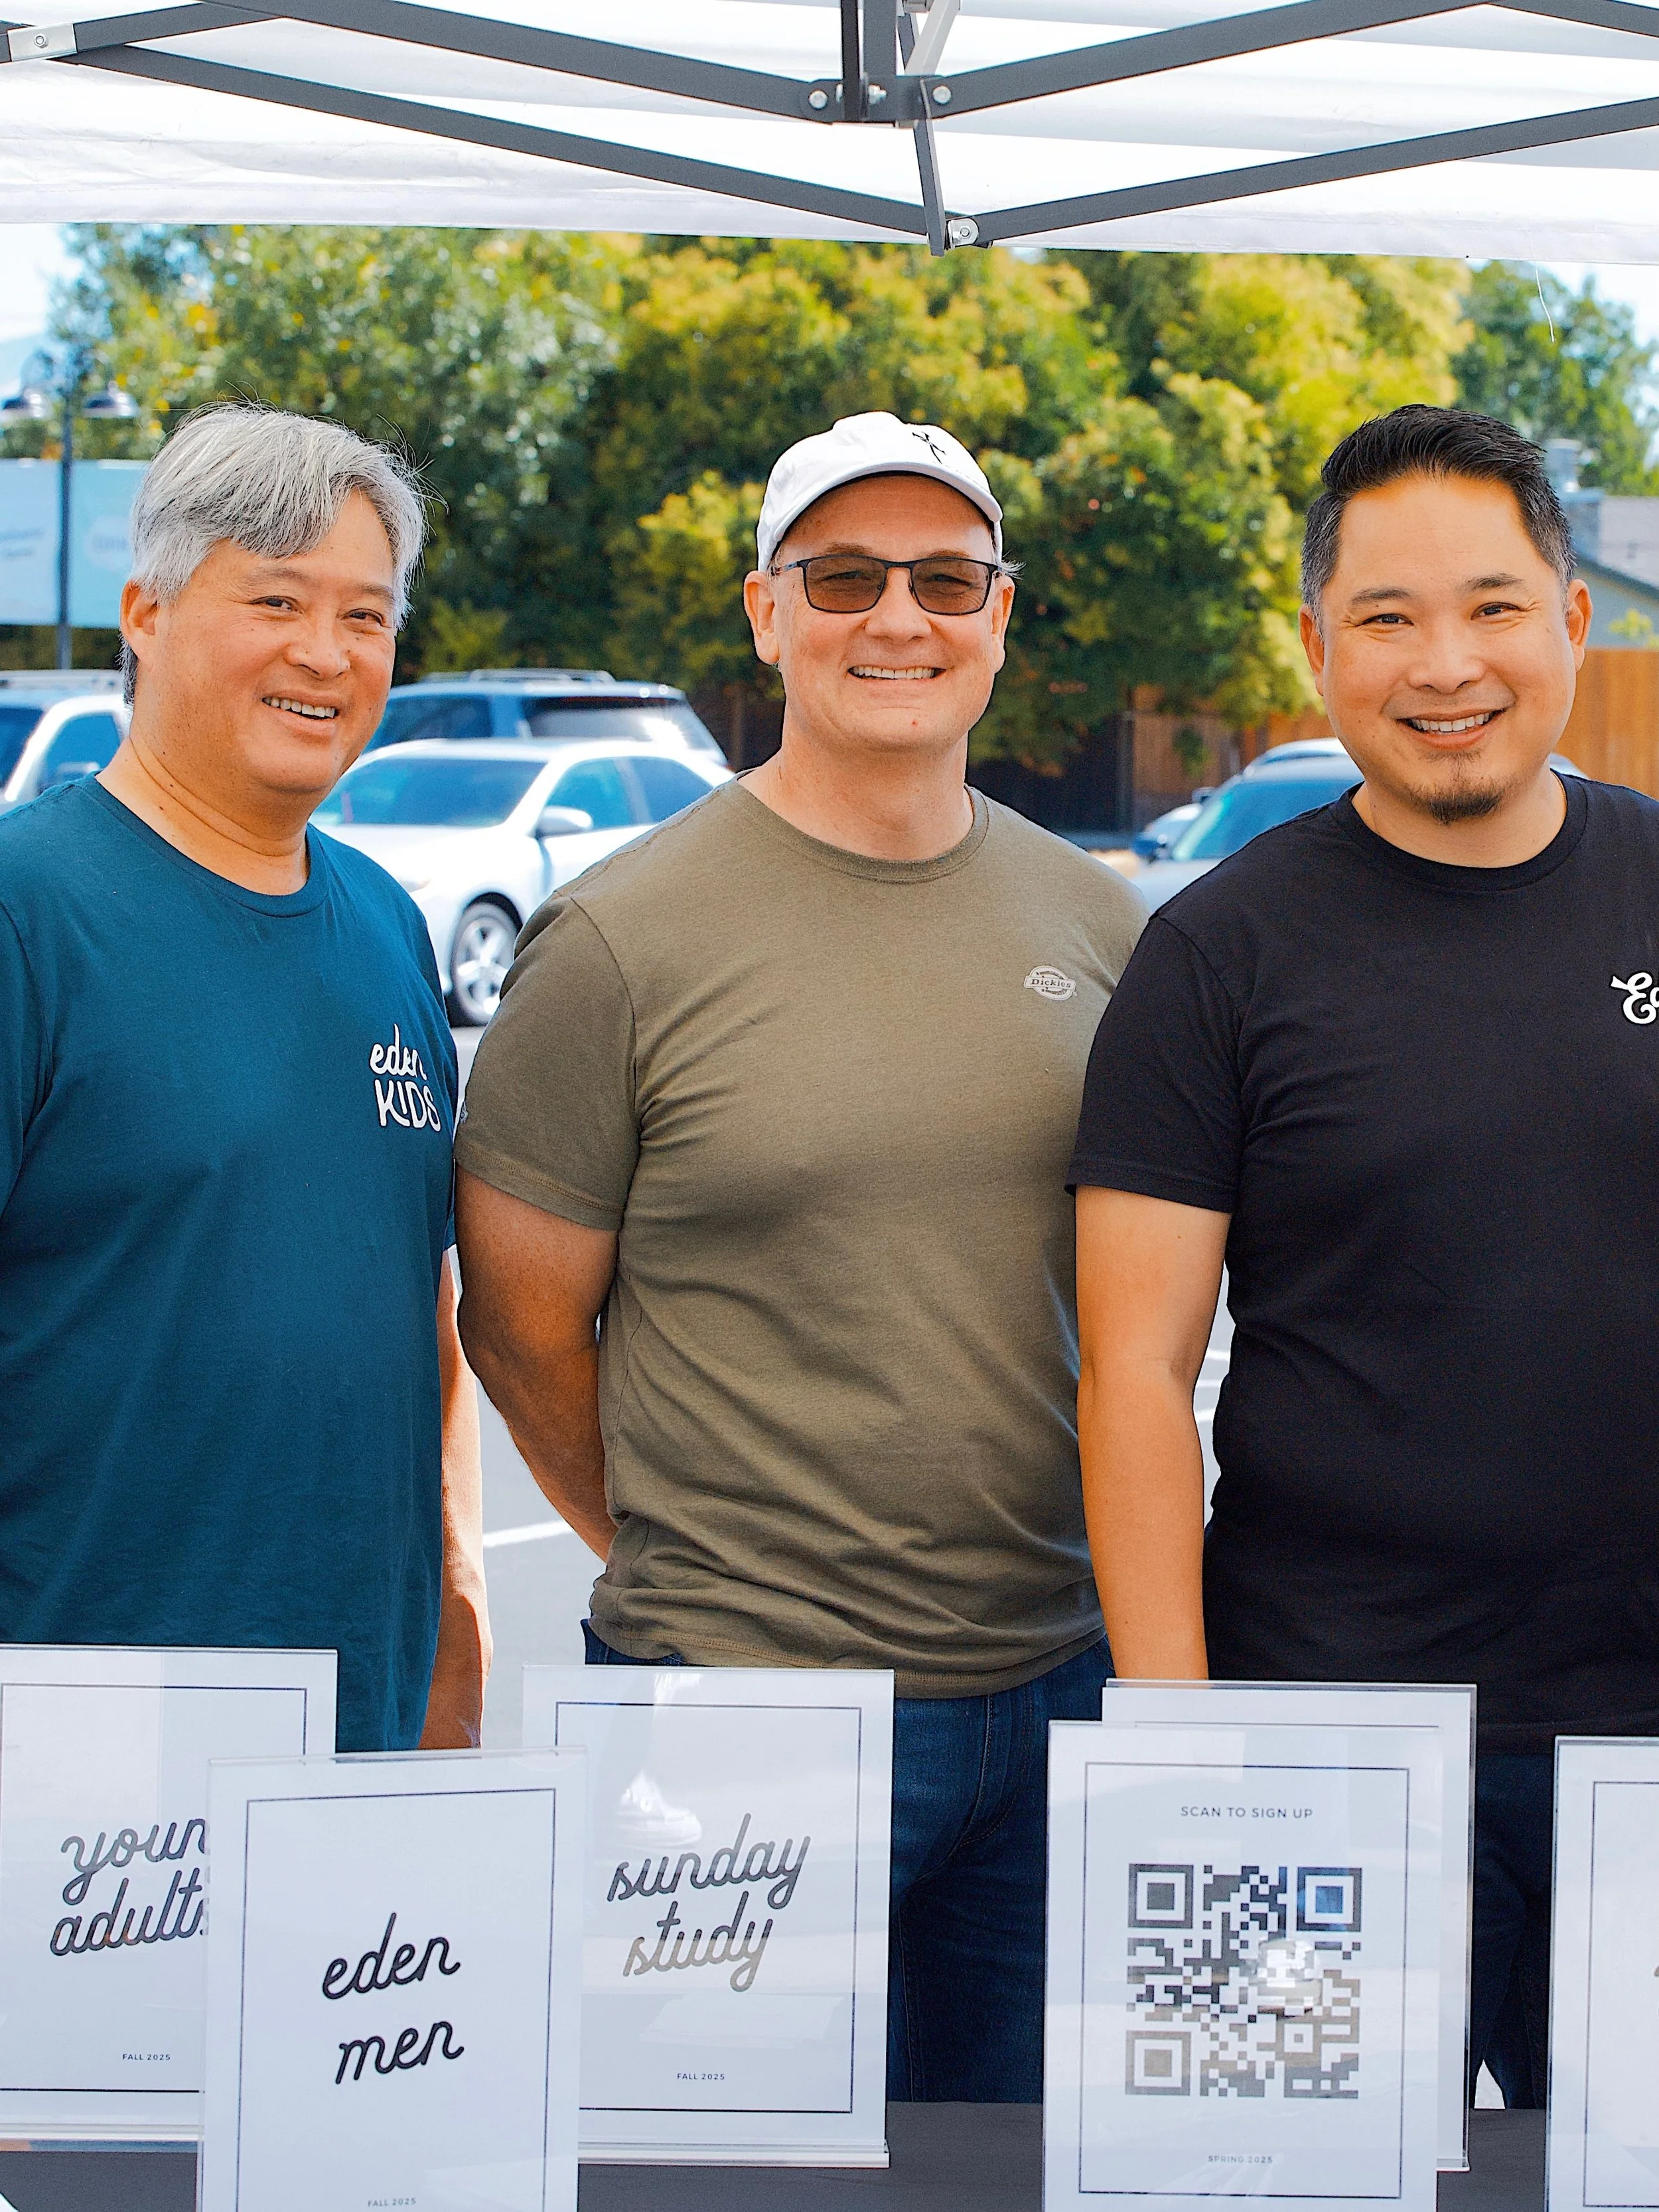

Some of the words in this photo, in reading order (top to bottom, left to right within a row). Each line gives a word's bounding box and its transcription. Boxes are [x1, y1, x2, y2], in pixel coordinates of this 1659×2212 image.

[1031, 978, 1071, 988] Dickies
[370, 1023, 427, 1080] eden
[374, 1079, 441, 1132] KIDS
[1181, 1806, 1221, 1818] SCAN
[1227, 1807, 1246, 1818] TO
[1251, 1807, 1287, 1818] SIGN
[1293, 1808, 1313, 1818] UP
[61, 1818, 207, 1905] youn
[607, 1812, 811, 1909] sunday
[323, 1912, 461, 2000] eden
[622, 1891, 773, 1992] study
[335, 2021, 465, 2084] men
[1208, 2155, 1245, 2164] SPRING
[1248, 2156, 1273, 2164] 2025
[368, 2199, 389, 2207] FALL
[392, 2197, 417, 2206] 2025
